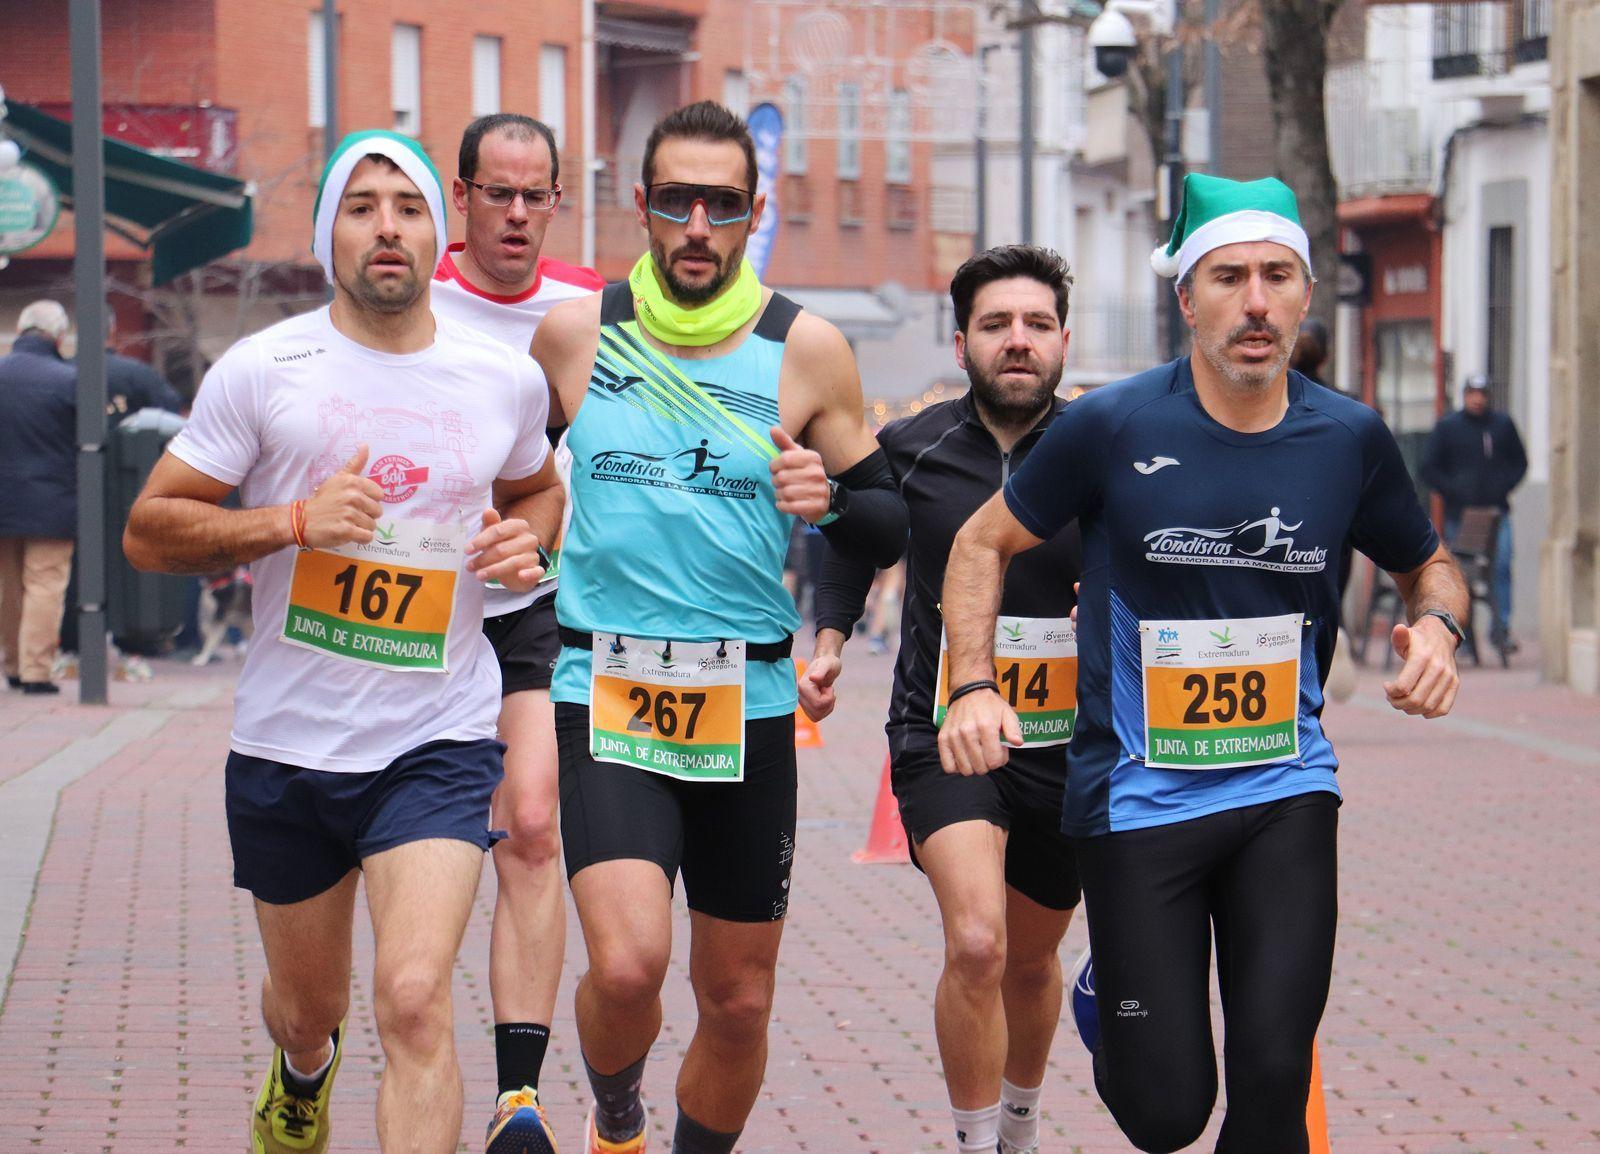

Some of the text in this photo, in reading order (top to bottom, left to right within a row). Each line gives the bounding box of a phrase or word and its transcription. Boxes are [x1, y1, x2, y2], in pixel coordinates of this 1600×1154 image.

[273, 350, 312, 363] luanvi
[594, 474, 651, 485] NAVALMORAL
[681, 486, 706, 494] MATA
[357, 543, 411, 558] Extremadura
[1151, 555, 1220, 565] NAVALMORAL
[1252, 561, 1281, 570] MATA
[334, 564, 423, 624] 167
[293, 615, 438, 660] JUNTA DE EXTREMADURA
[996, 642, 1037, 651] xtremadura
[1198, 649, 1250, 659] Extremadura
[641, 667, 691, 679] Extremadura
[992, 662, 1049, 708] 14
[1183, 670, 1267, 724] 258
[626, 686, 706, 740] 267
[1019, 719, 1070, 735] REMADURA
[599, 737, 735, 769] JUNTA DE EXTREMADURA
[1155, 732, 1291, 756] JUNTA DE EXTREMADURA
[1116, 1010, 1149, 1018] Kalenji
